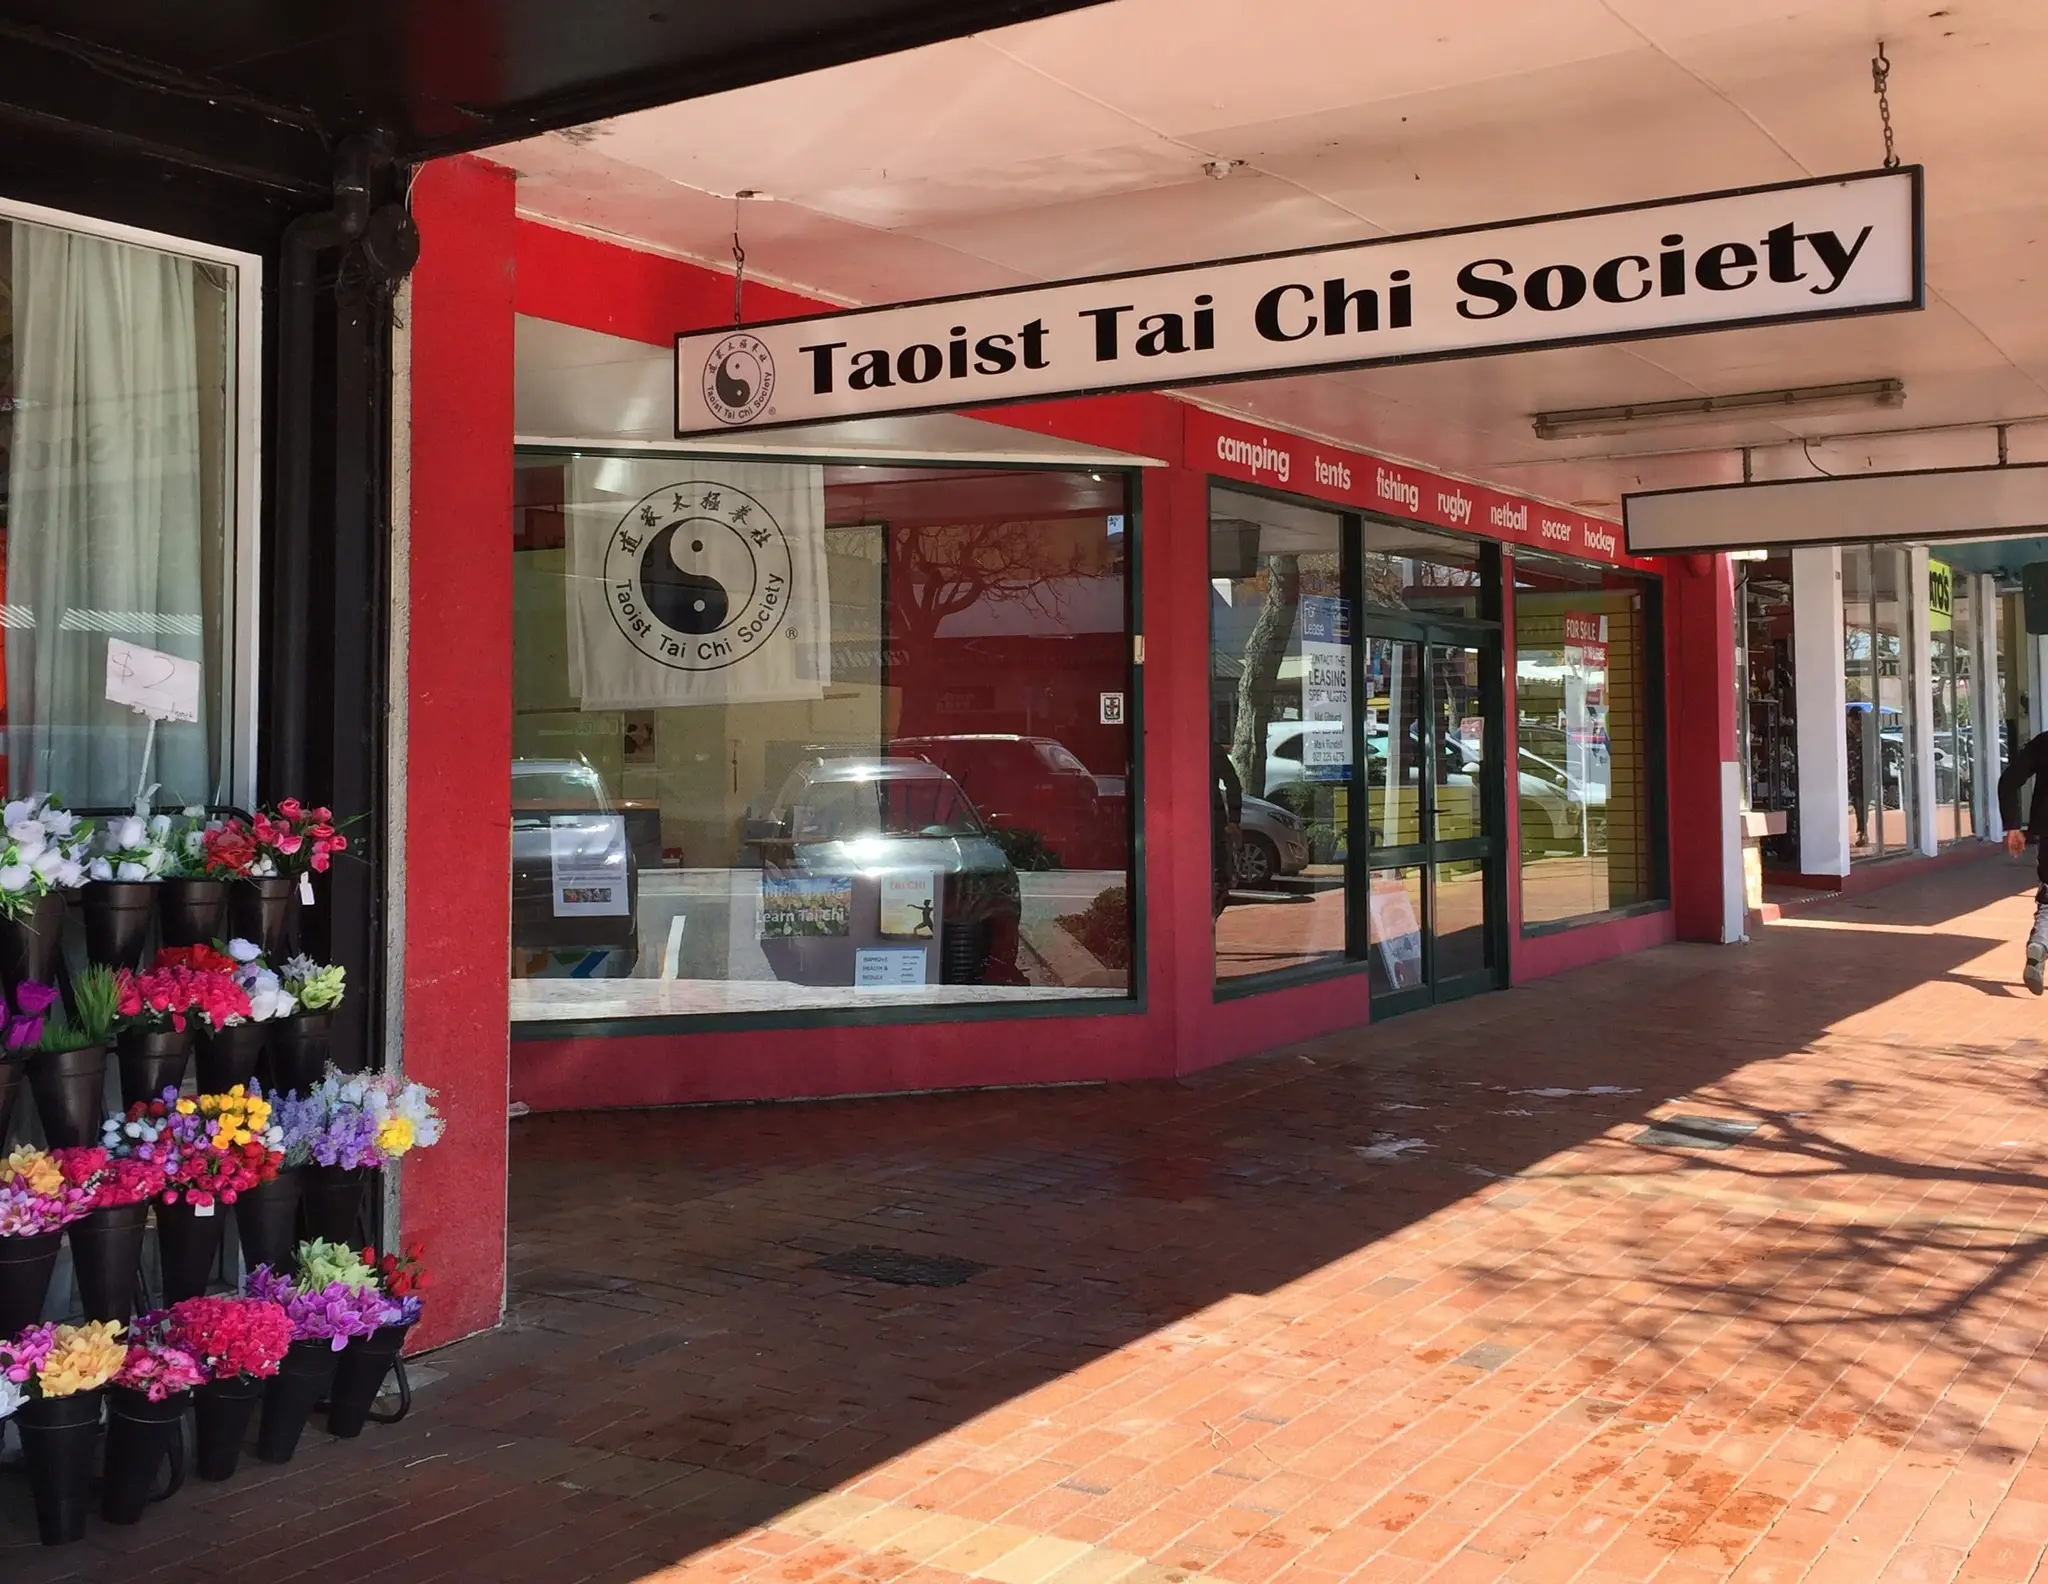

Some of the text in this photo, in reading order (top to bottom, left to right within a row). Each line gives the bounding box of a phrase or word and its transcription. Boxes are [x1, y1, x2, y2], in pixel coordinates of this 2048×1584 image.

[798, 221, 1874, 395] Taoist Tai Chi Society
[707, 371, 772, 419] Taoist Tai Chi Society
[1217, 435, 1616, 558] camping tents fishing rugby netball soccer hockey
[616, 572, 785, 660] Taoist Tai Chi Society
[1304, 619, 1325, 637] Lease
[1565, 618, 1580, 639] FOR
[1580, 620, 1598, 641] SALE
[1308, 668, 1347, 688] LEASING
[1308, 688, 1349, 703] SPEALISTS
[907, 879, 927, 890] CHI
[756, 907, 844, 924] Learn Tai Chi
